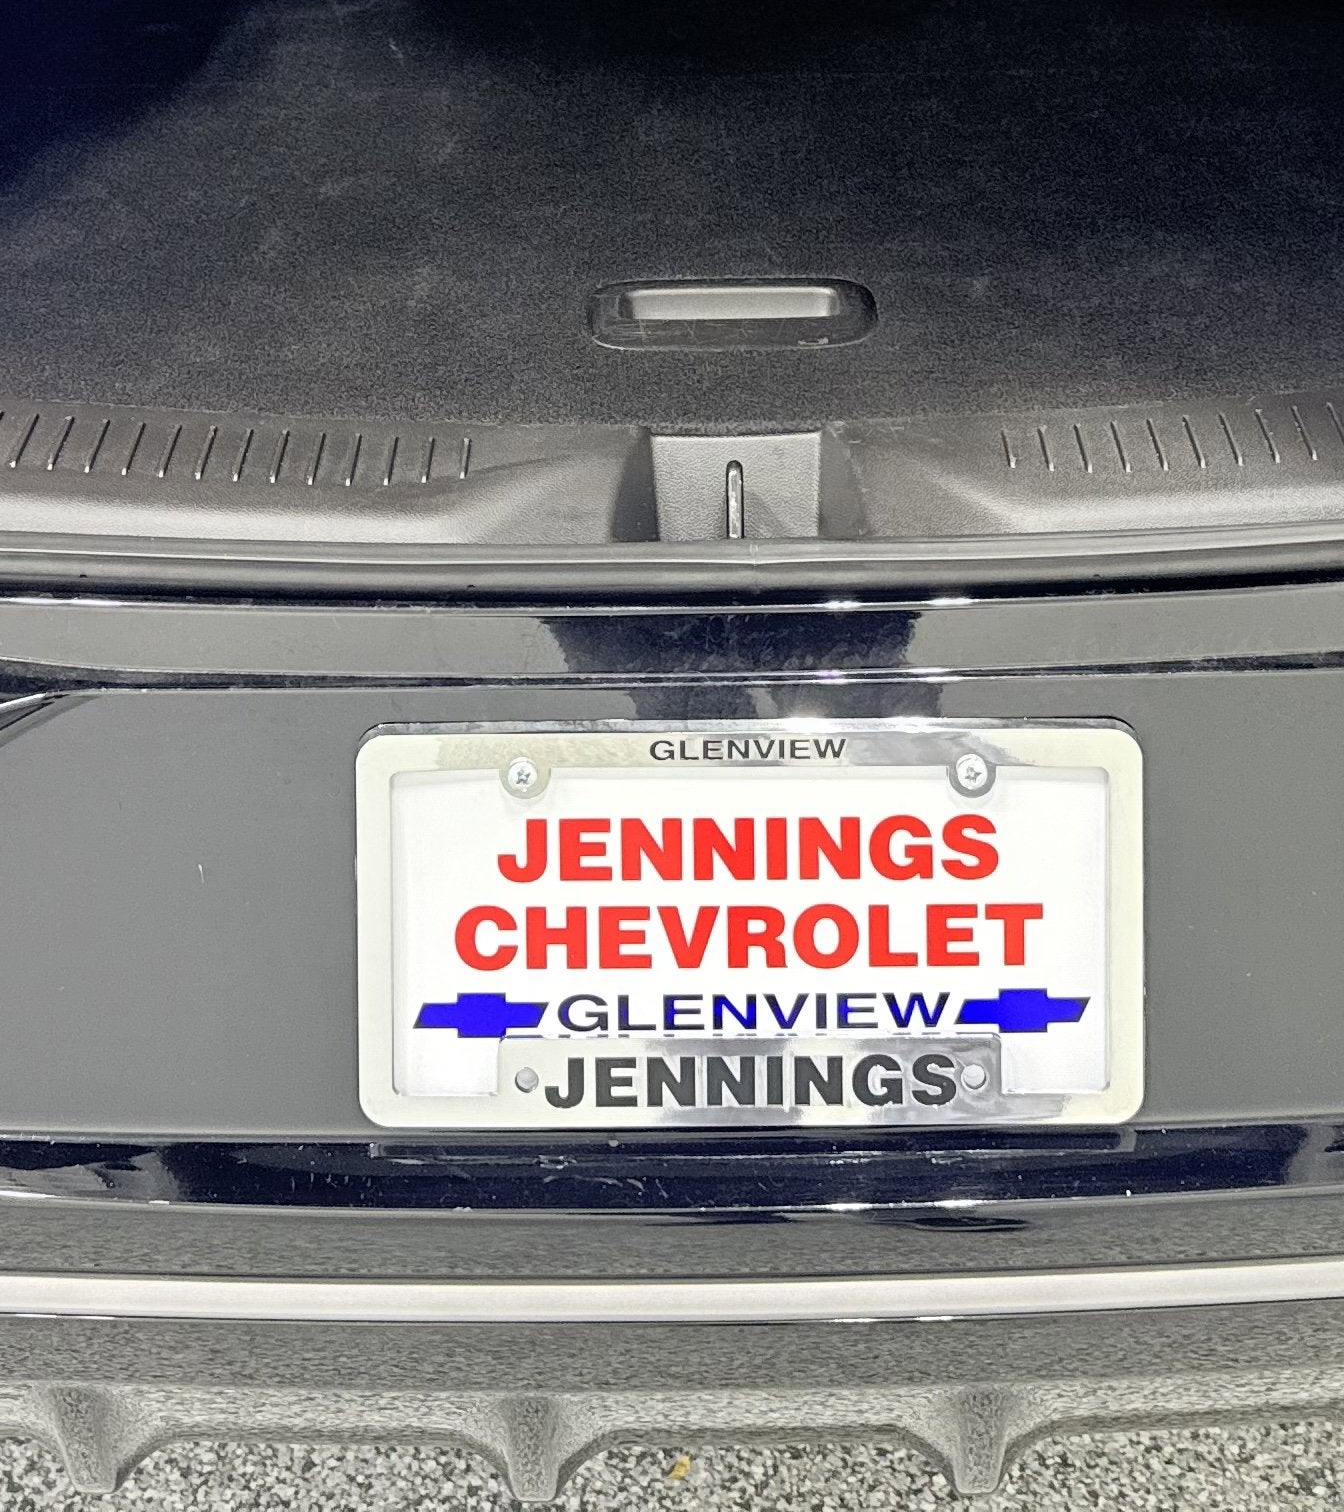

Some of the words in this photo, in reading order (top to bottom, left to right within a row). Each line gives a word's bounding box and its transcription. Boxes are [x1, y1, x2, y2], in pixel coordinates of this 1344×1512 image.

[649, 738, 847, 761] GLENVIEW
[497, 814, 1000, 883] JENNINGS
[455, 902, 1044, 971] CHEVROLET
[557, 991, 952, 1032] GLENVIEW
[544, 1053, 958, 1109] JENNINGS
